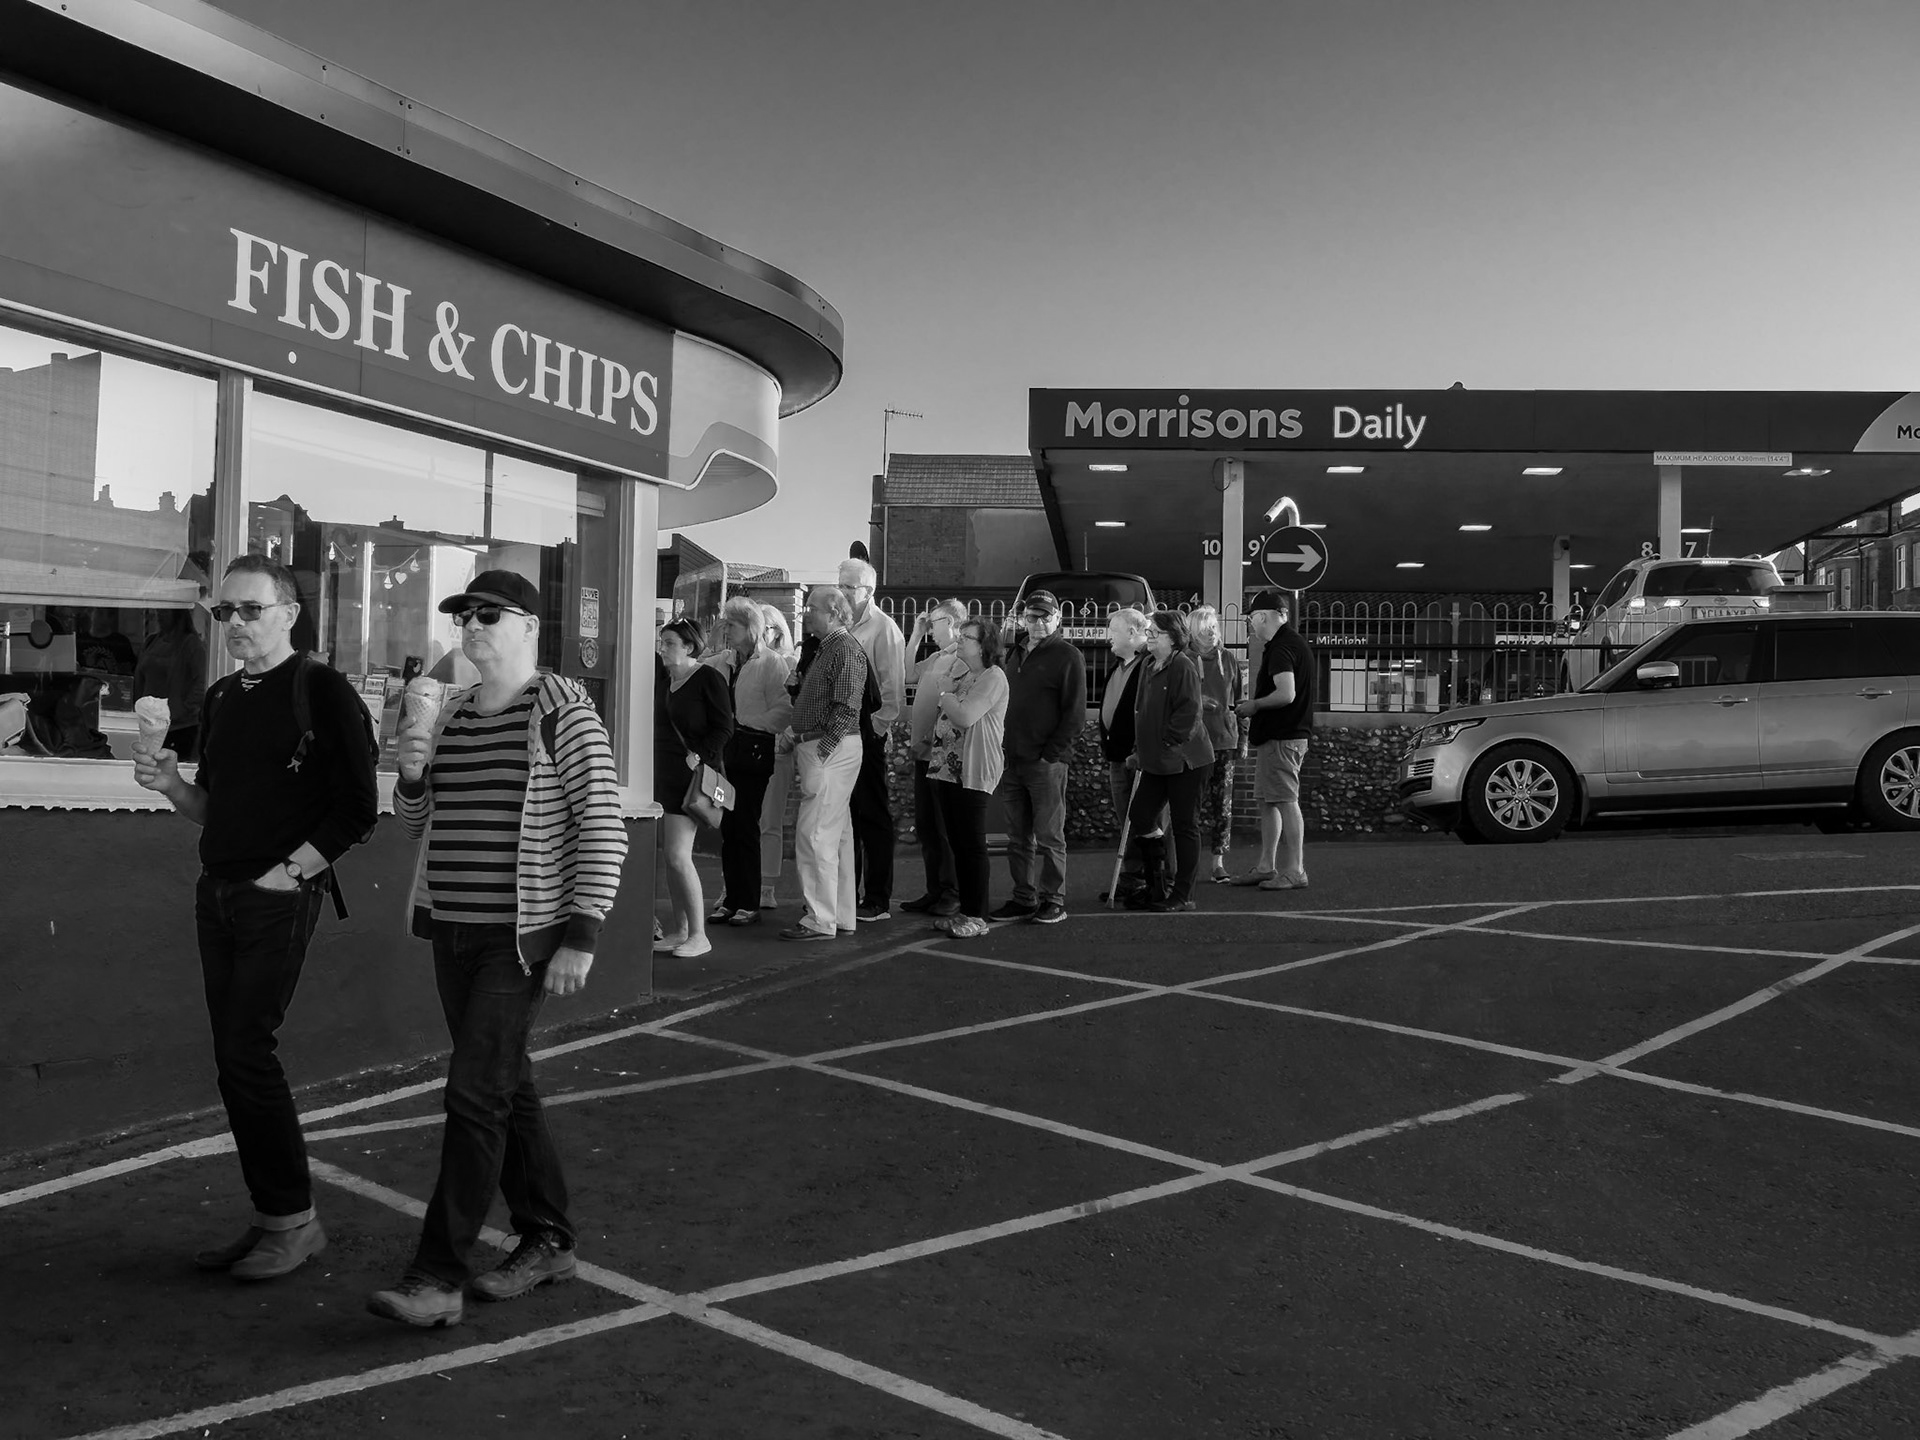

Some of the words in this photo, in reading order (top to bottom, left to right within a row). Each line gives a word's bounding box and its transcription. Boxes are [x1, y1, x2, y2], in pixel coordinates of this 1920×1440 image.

[227, 226, 412, 361] FISH
[428, 300, 476, 381] &
[489, 323, 660, 437] CHIPS
[1064, 394, 1303, 439] Morrisons
[1332, 403, 1427, 449] Daily
[1201, 539, 1221, 556] 10
[1248, 539, 1261, 557] 9
[1641, 541, 1654, 557] 8
[1685, 541, 1697, 558] 7
[1189, 592, 1201, 605] 4
[1538, 591, 1548, 605] 2
[1573, 591, 1580, 605] 1
[1316, 635, 1367, 645] Midnight
